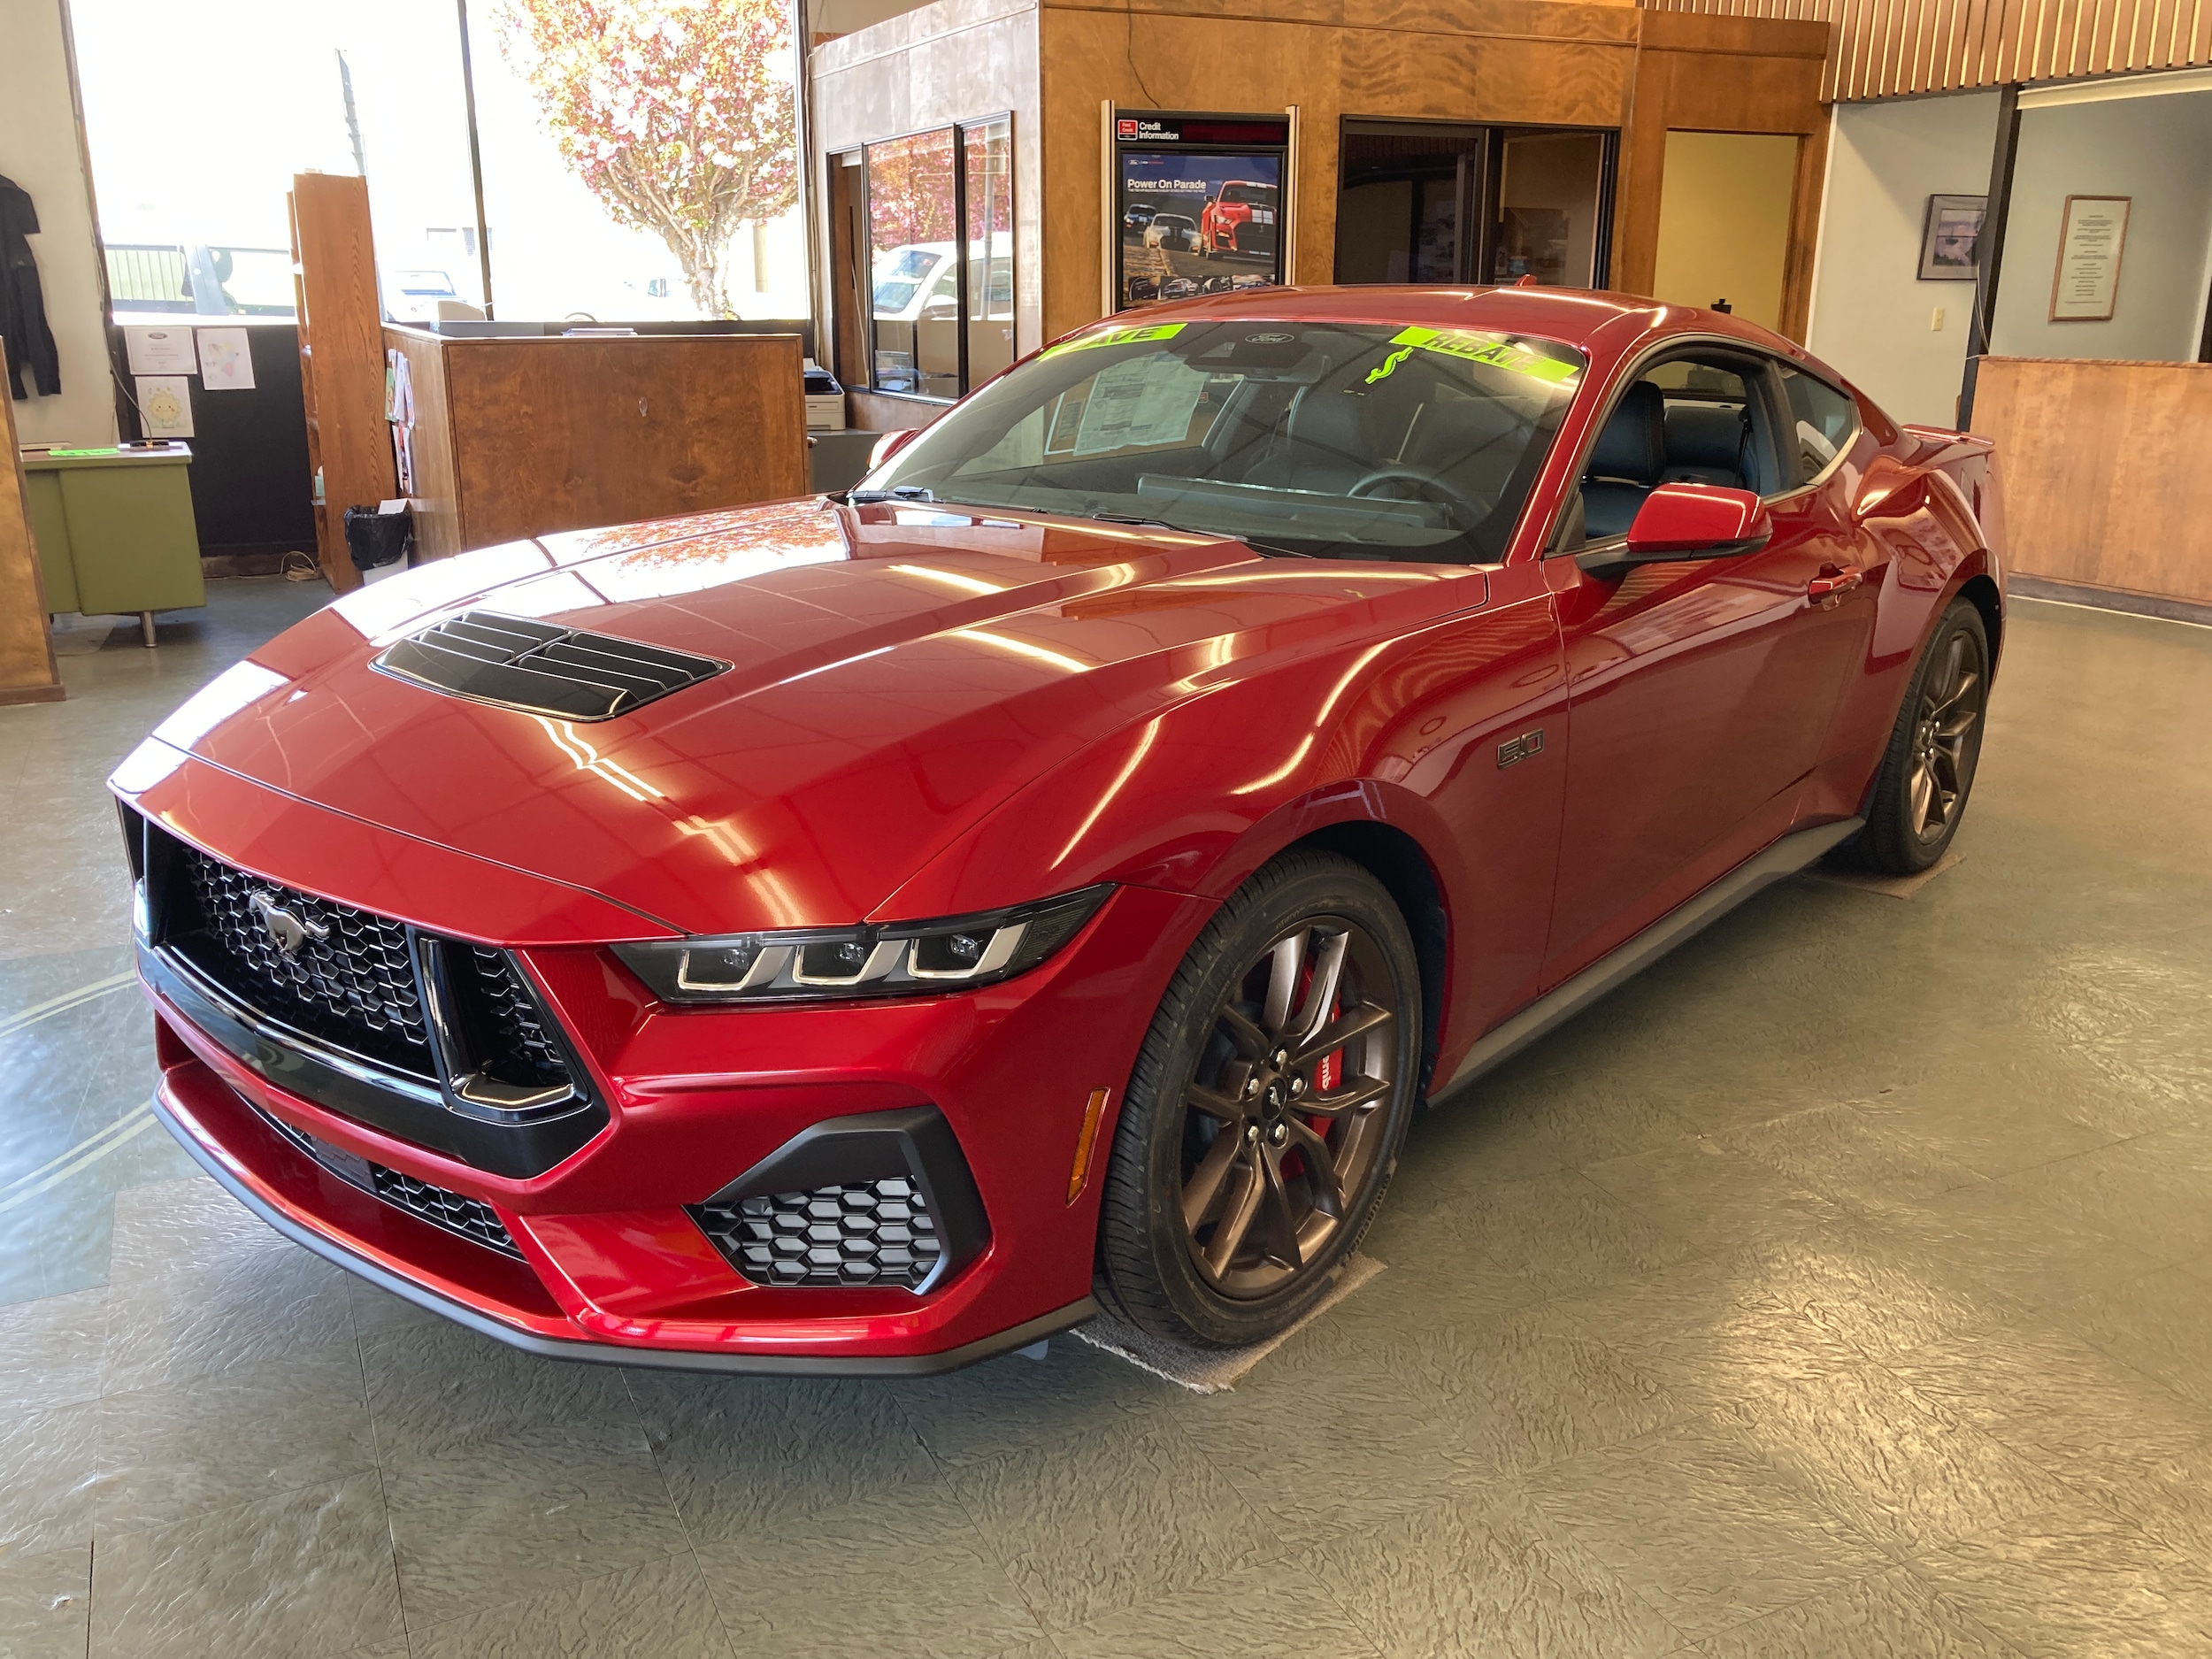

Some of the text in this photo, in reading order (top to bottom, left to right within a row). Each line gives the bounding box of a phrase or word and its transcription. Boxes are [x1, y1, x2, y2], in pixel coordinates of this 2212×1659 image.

[1139, 121, 1161, 131] Credit
[1139, 131, 1179, 140] Information
[1127, 179, 1207, 189] Power On Parade
[1087, 327, 1163, 346] AVE
[1249, 334, 1288, 343] Ford
[1421, 332, 1547, 373] REBATE
[1497, 729, 1544, 770] 5.0
